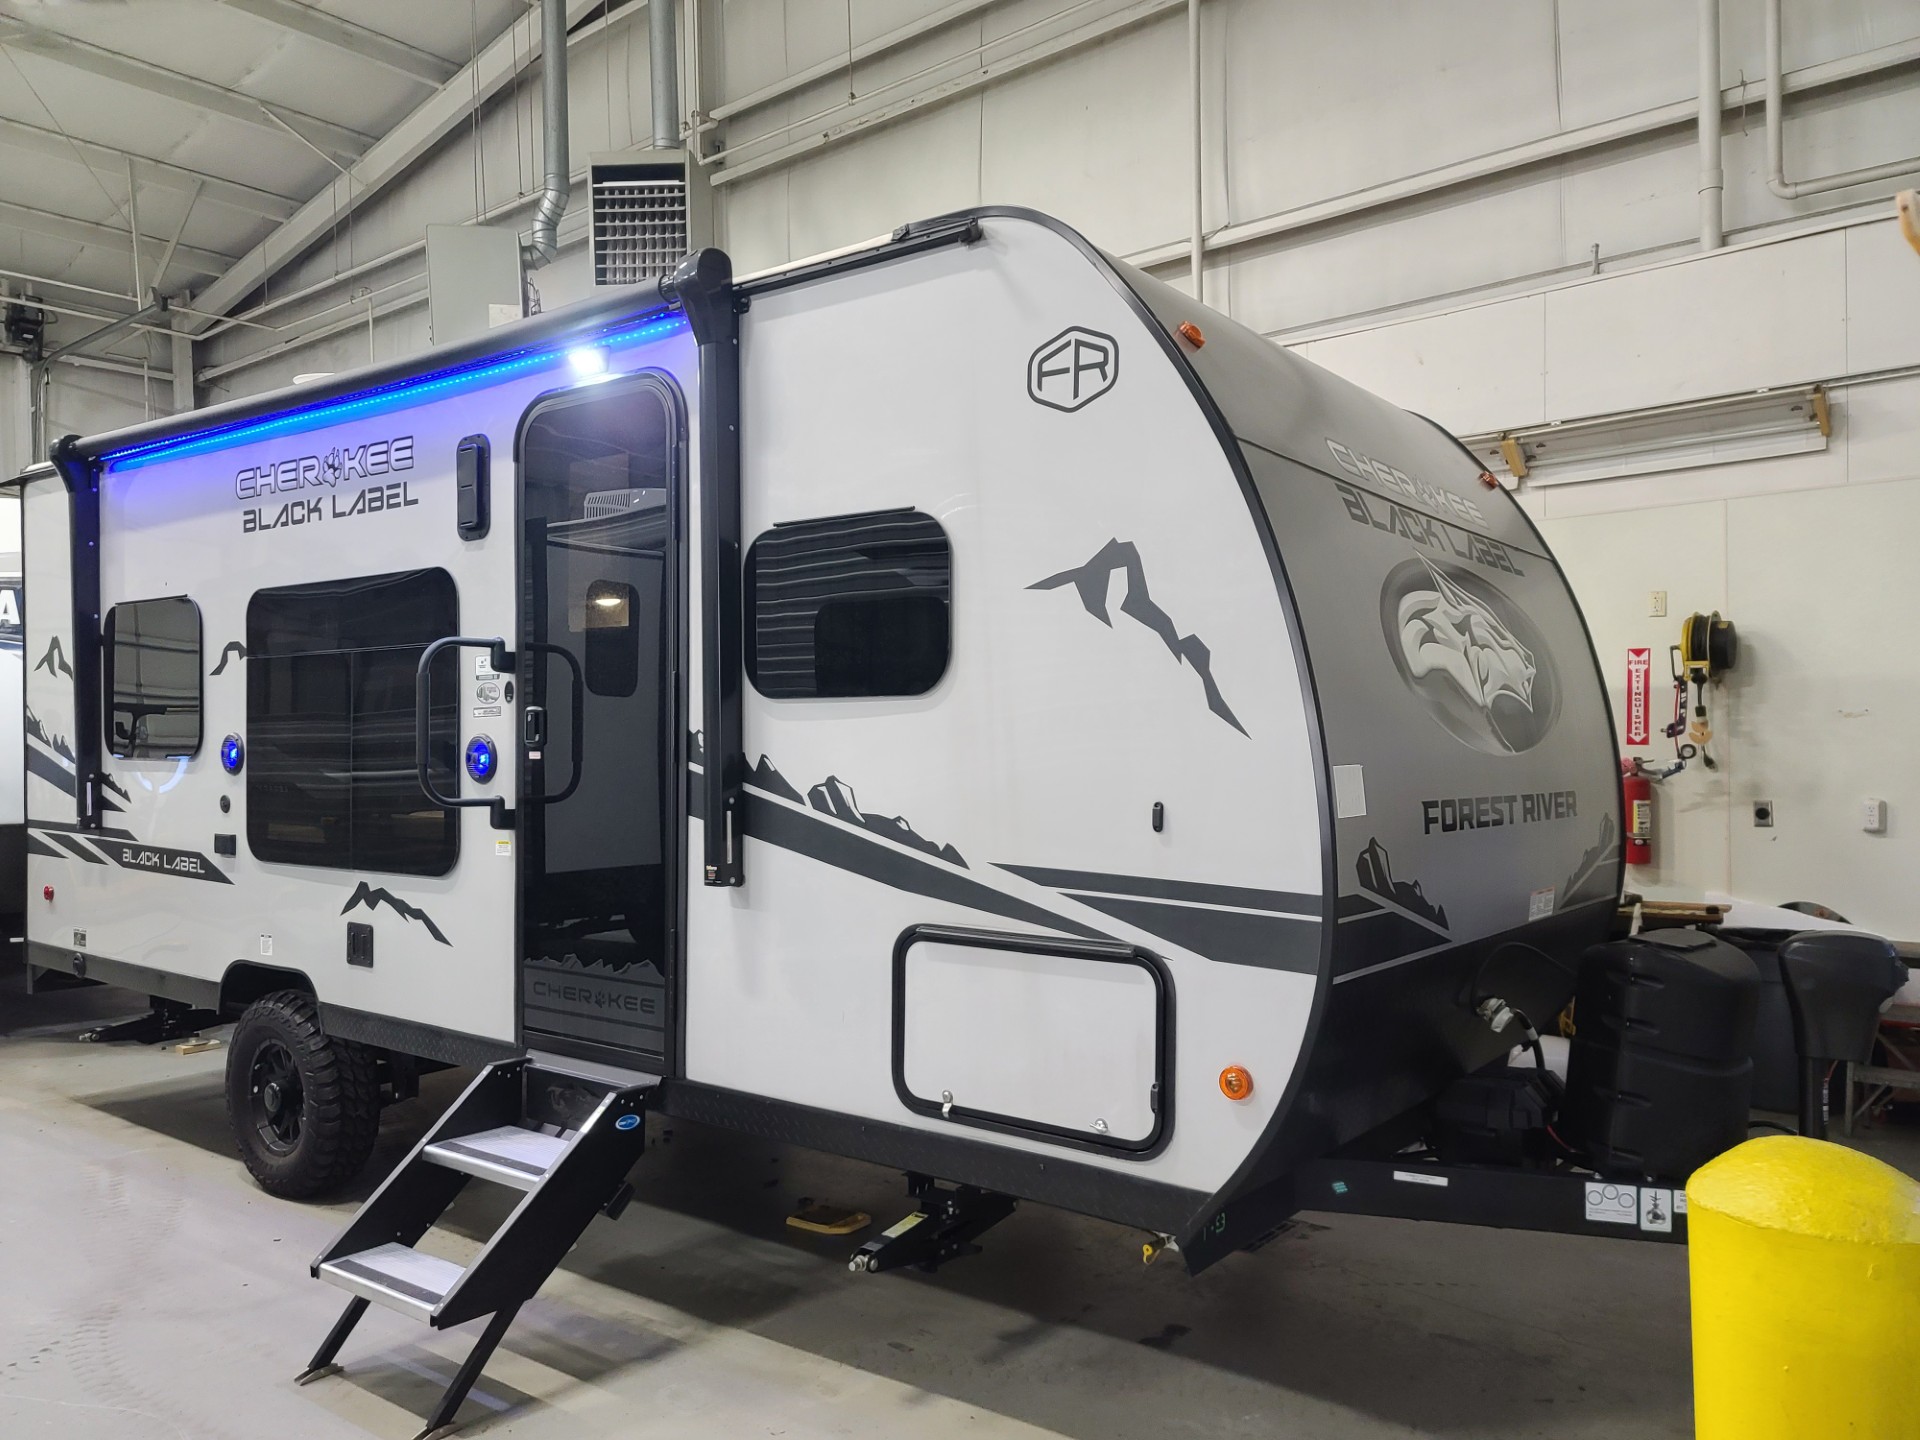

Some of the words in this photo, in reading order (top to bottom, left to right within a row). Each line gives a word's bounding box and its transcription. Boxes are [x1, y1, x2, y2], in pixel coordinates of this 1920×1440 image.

[1036, 337, 1109, 401] FR
[243, 496, 323, 533] BLACK
[332, 481, 419, 519] LABEL
[1335, 482, 1446, 551] BLACK
[1440, 524, 1525, 577] LABEL
[1634, 668, 1642, 737] EXTINGUISHER
[1421, 795, 1518, 835] FOREST
[1521, 790, 1578, 823] RIVER
[122, 848, 160, 867] BLACK
[163, 854, 206, 874] LABEL
